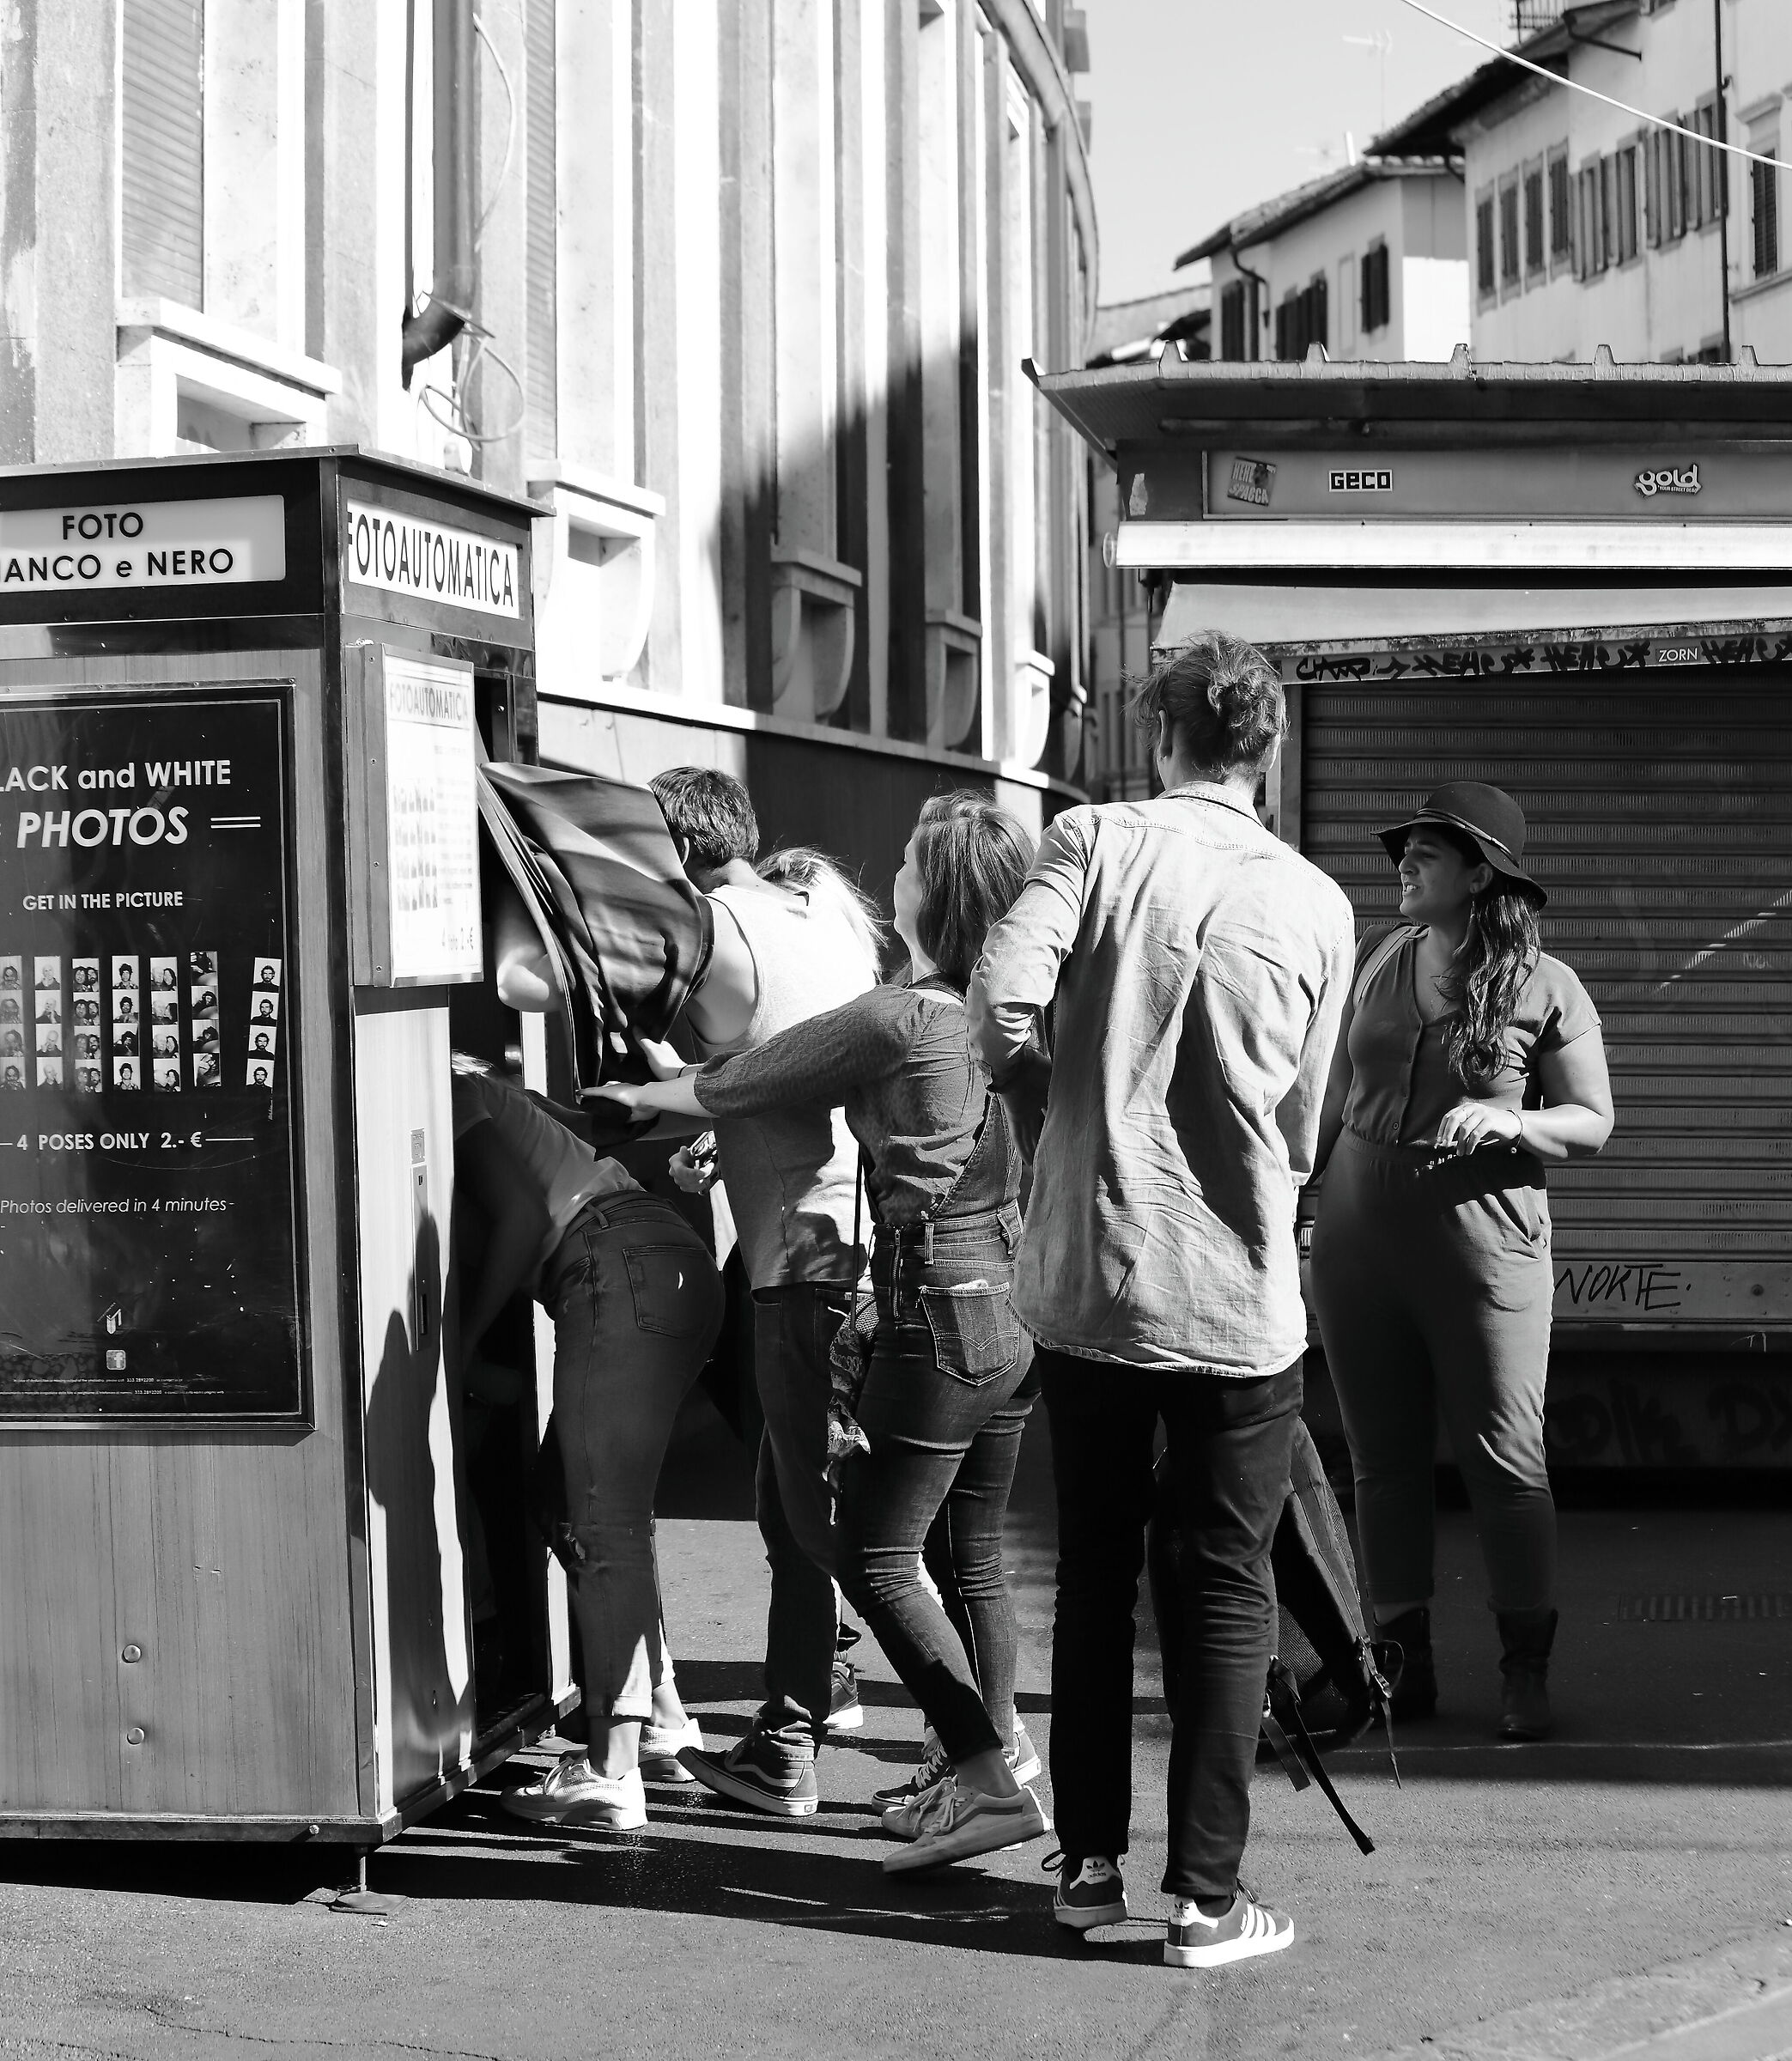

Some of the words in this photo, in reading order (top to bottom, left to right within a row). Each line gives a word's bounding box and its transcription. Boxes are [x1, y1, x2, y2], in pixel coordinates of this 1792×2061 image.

[1635, 464, 1701, 496] gold
[62, 512, 144, 540] FOTO
[116, 559, 133, 578] e
[148, 548, 234, 576] NERO
[1658, 647, 1698, 662] ZORN
[77, 762, 136, 789] and
[144, 759, 232, 787] WHITE
[16, 806, 189, 848] PHOTOS
[22, 895, 54, 911] GET
[58, 894, 76, 909] IN
[81, 893, 111, 909] THE
[115, 891, 184, 909] PICTURE
[16, 1134, 28, 1151] 4
[38, 1134, 94, 1151] POSES
[100, 1133, 150, 1150] ONLY
[0, 1200, 52, 1213] Photos
[56, 1198, 130, 1213] delivered
[134, 1198, 147, 1212] in
[151, 1199, 161, 1212] 4
